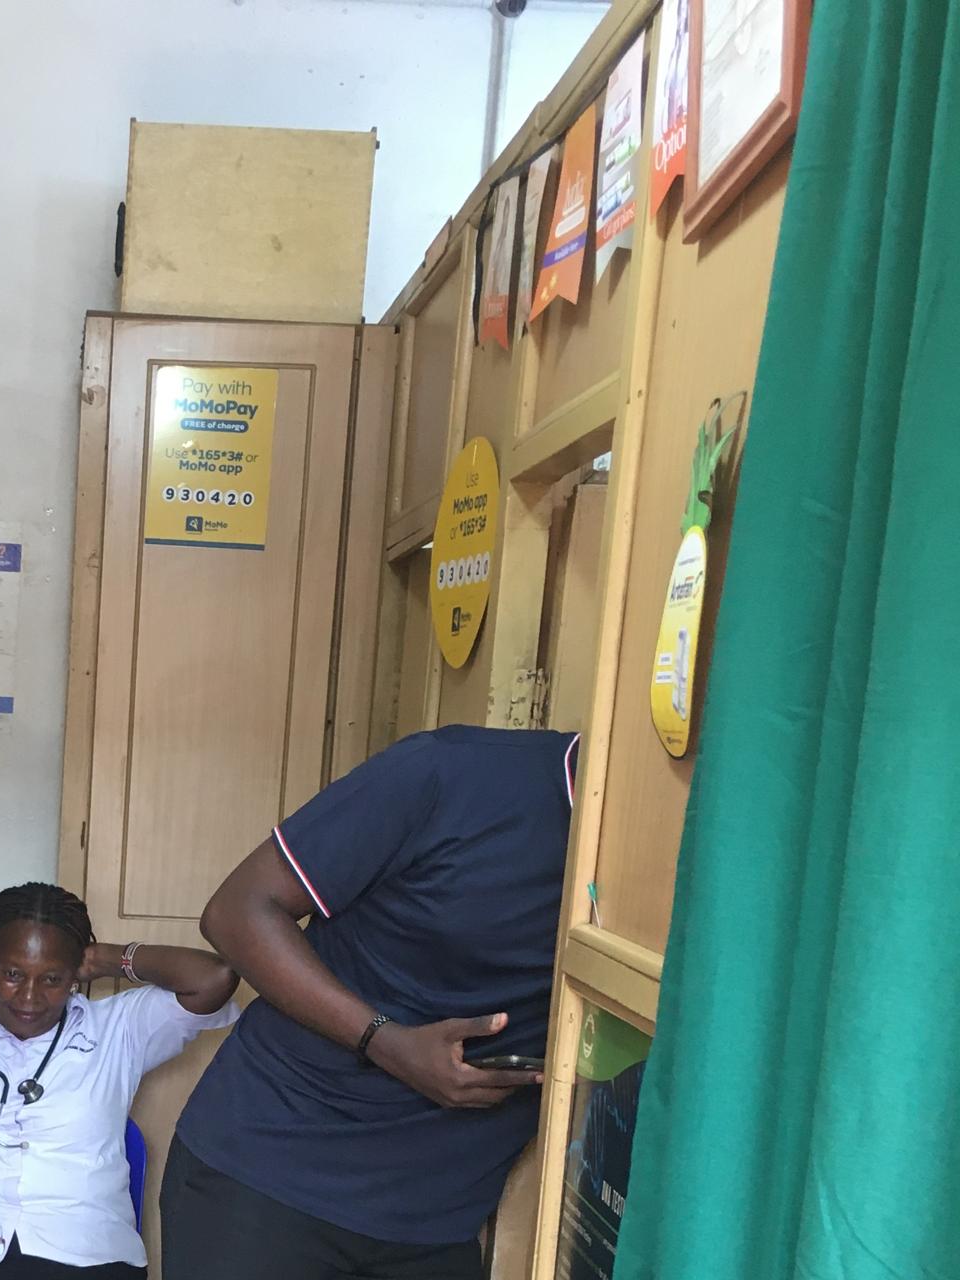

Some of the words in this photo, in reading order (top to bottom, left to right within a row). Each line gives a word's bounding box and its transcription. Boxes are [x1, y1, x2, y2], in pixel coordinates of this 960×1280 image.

[182, 378, 213, 397] Pay
[218, 380, 252, 396] with
[174, 398, 258, 419] MoMoPay
[184, 420, 205, 429] FREE
[207, 421, 216, 429] of
[217, 423, 245, 431] charge
[165, 448, 188, 459] Use
[245, 454, 259, 463] or
[179, 460, 216, 472] MoMo
[219, 465, 243, 476] app
[466, 472, 479, 488] Use
[452, 496, 473, 515] MoMo
[474, 494, 487, 512] app
[204, 520, 228, 529] MoMo
